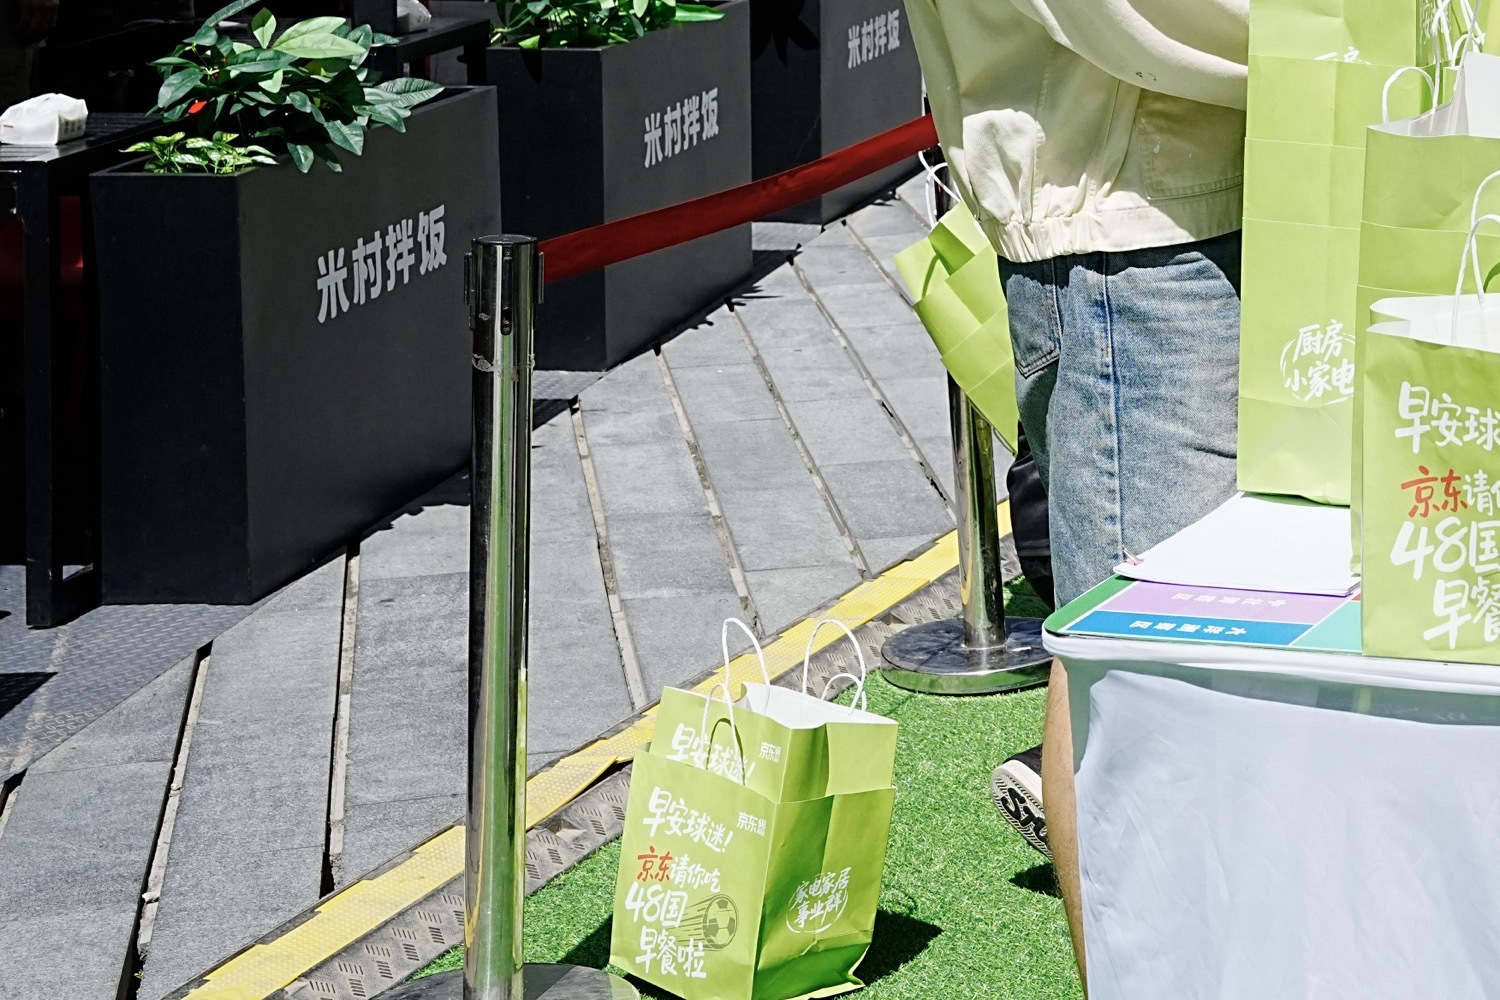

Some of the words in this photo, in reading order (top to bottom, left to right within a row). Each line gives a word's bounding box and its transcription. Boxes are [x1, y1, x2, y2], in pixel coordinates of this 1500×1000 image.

[847, 9, 900, 69] 米村拌饭
[644, 87, 719, 168] 米村拌饭
[317, 204, 447, 323] 米村拌饭
[1293, 319, 1344, 366] 厨房
[1284, 358, 1355, 401] 小家电
[643, 786, 734, 853] 早安球迷!
[637, 846, 721, 893] 京东请你吃
[789, 866, 851, 911] 家电家居
[625, 882, 689, 928] 48国
[635, 926, 708, 980] 早餐啦
